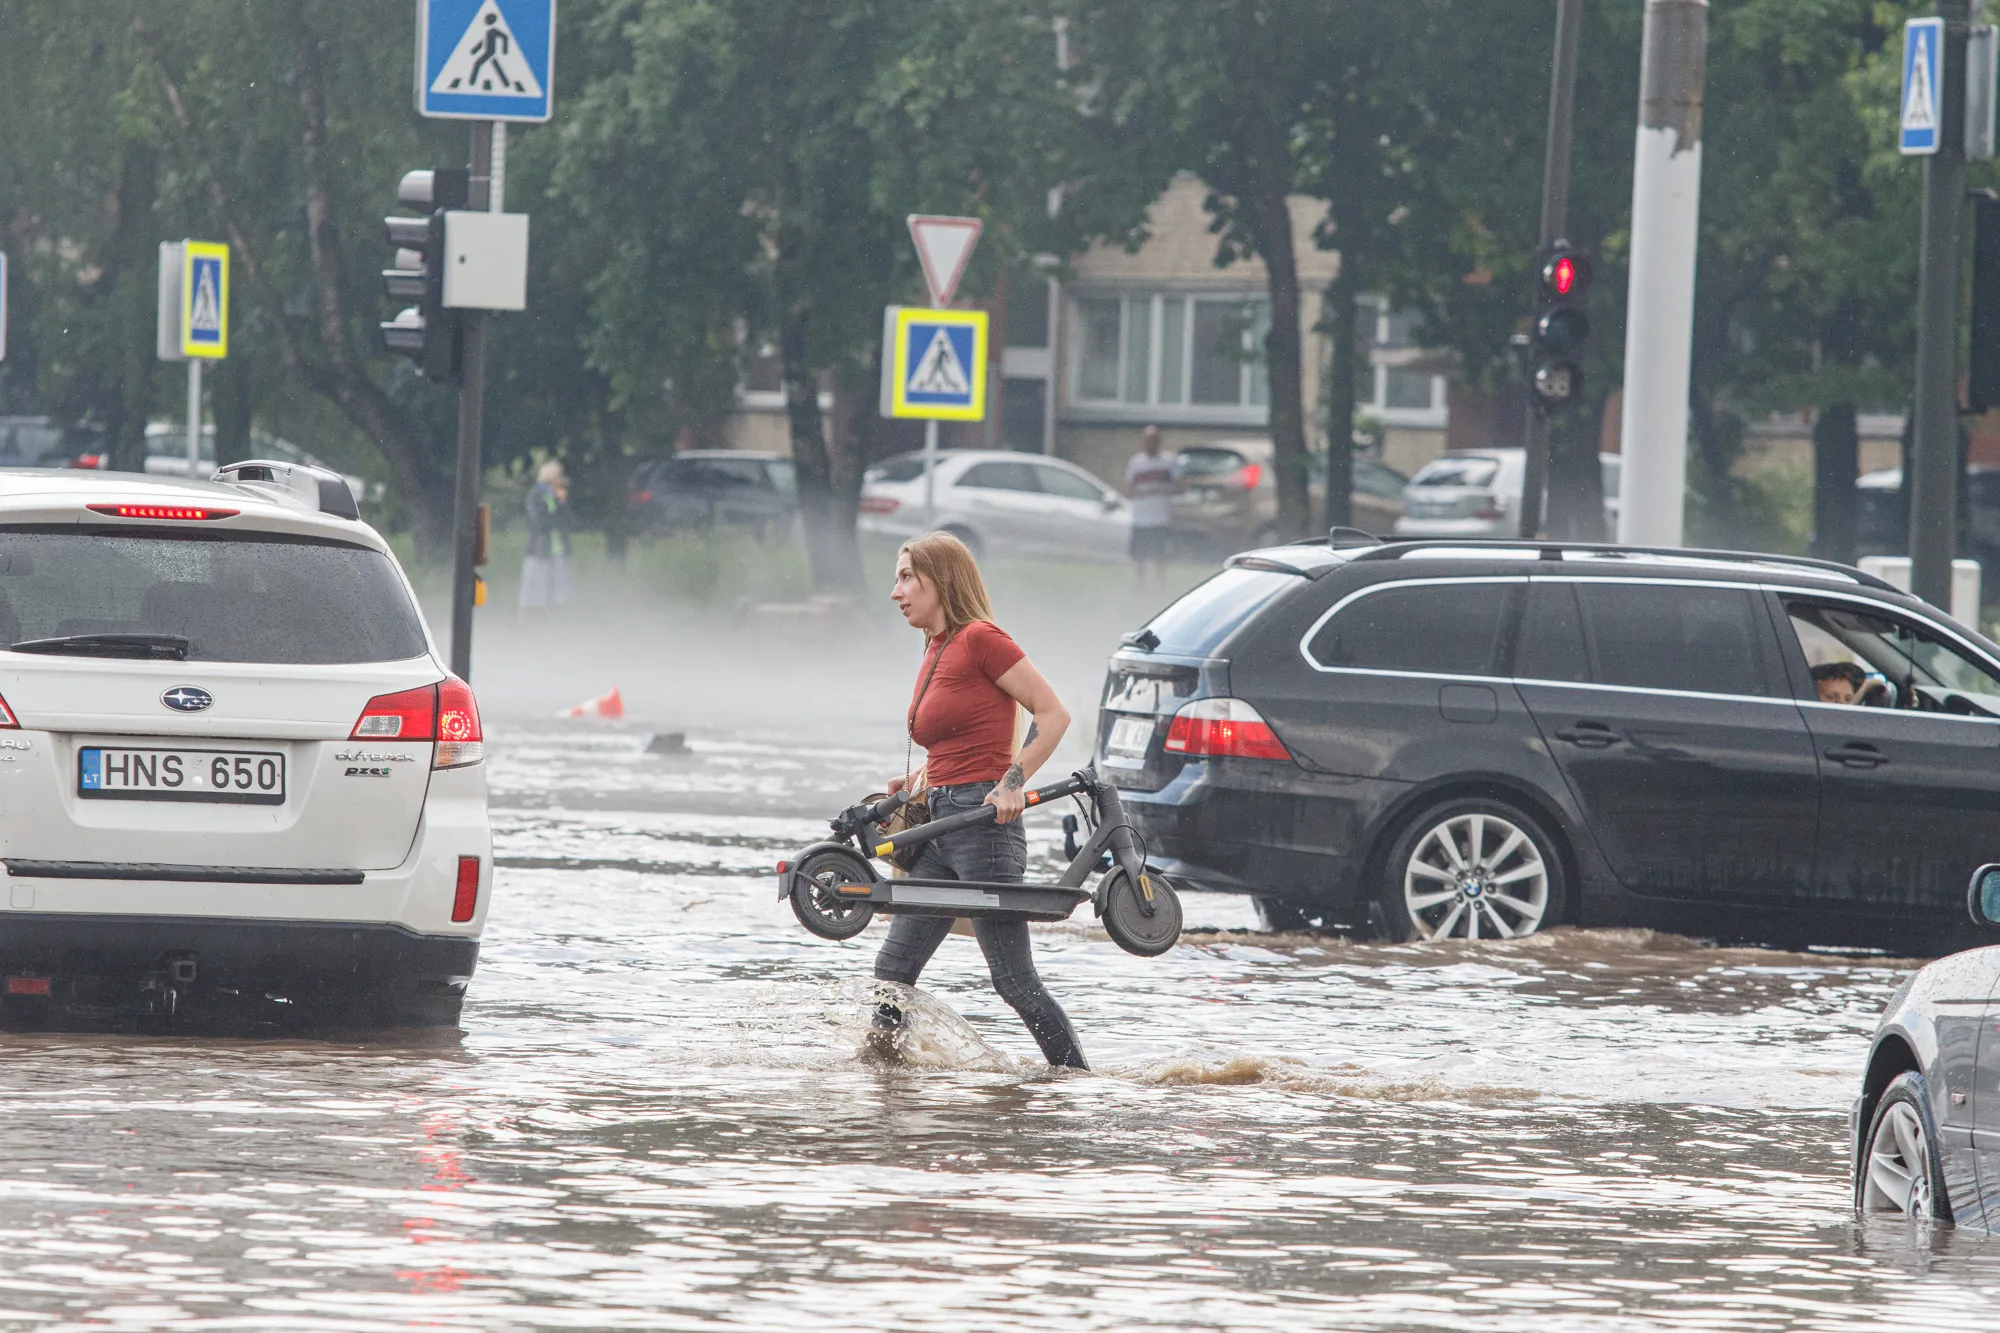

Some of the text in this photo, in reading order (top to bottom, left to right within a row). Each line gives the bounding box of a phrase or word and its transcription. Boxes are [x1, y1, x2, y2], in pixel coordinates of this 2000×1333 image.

[335, 749, 415, 762] OUTBACK
[84, 773, 99, 783] LT
[105, 754, 276, 790] HNS 650
